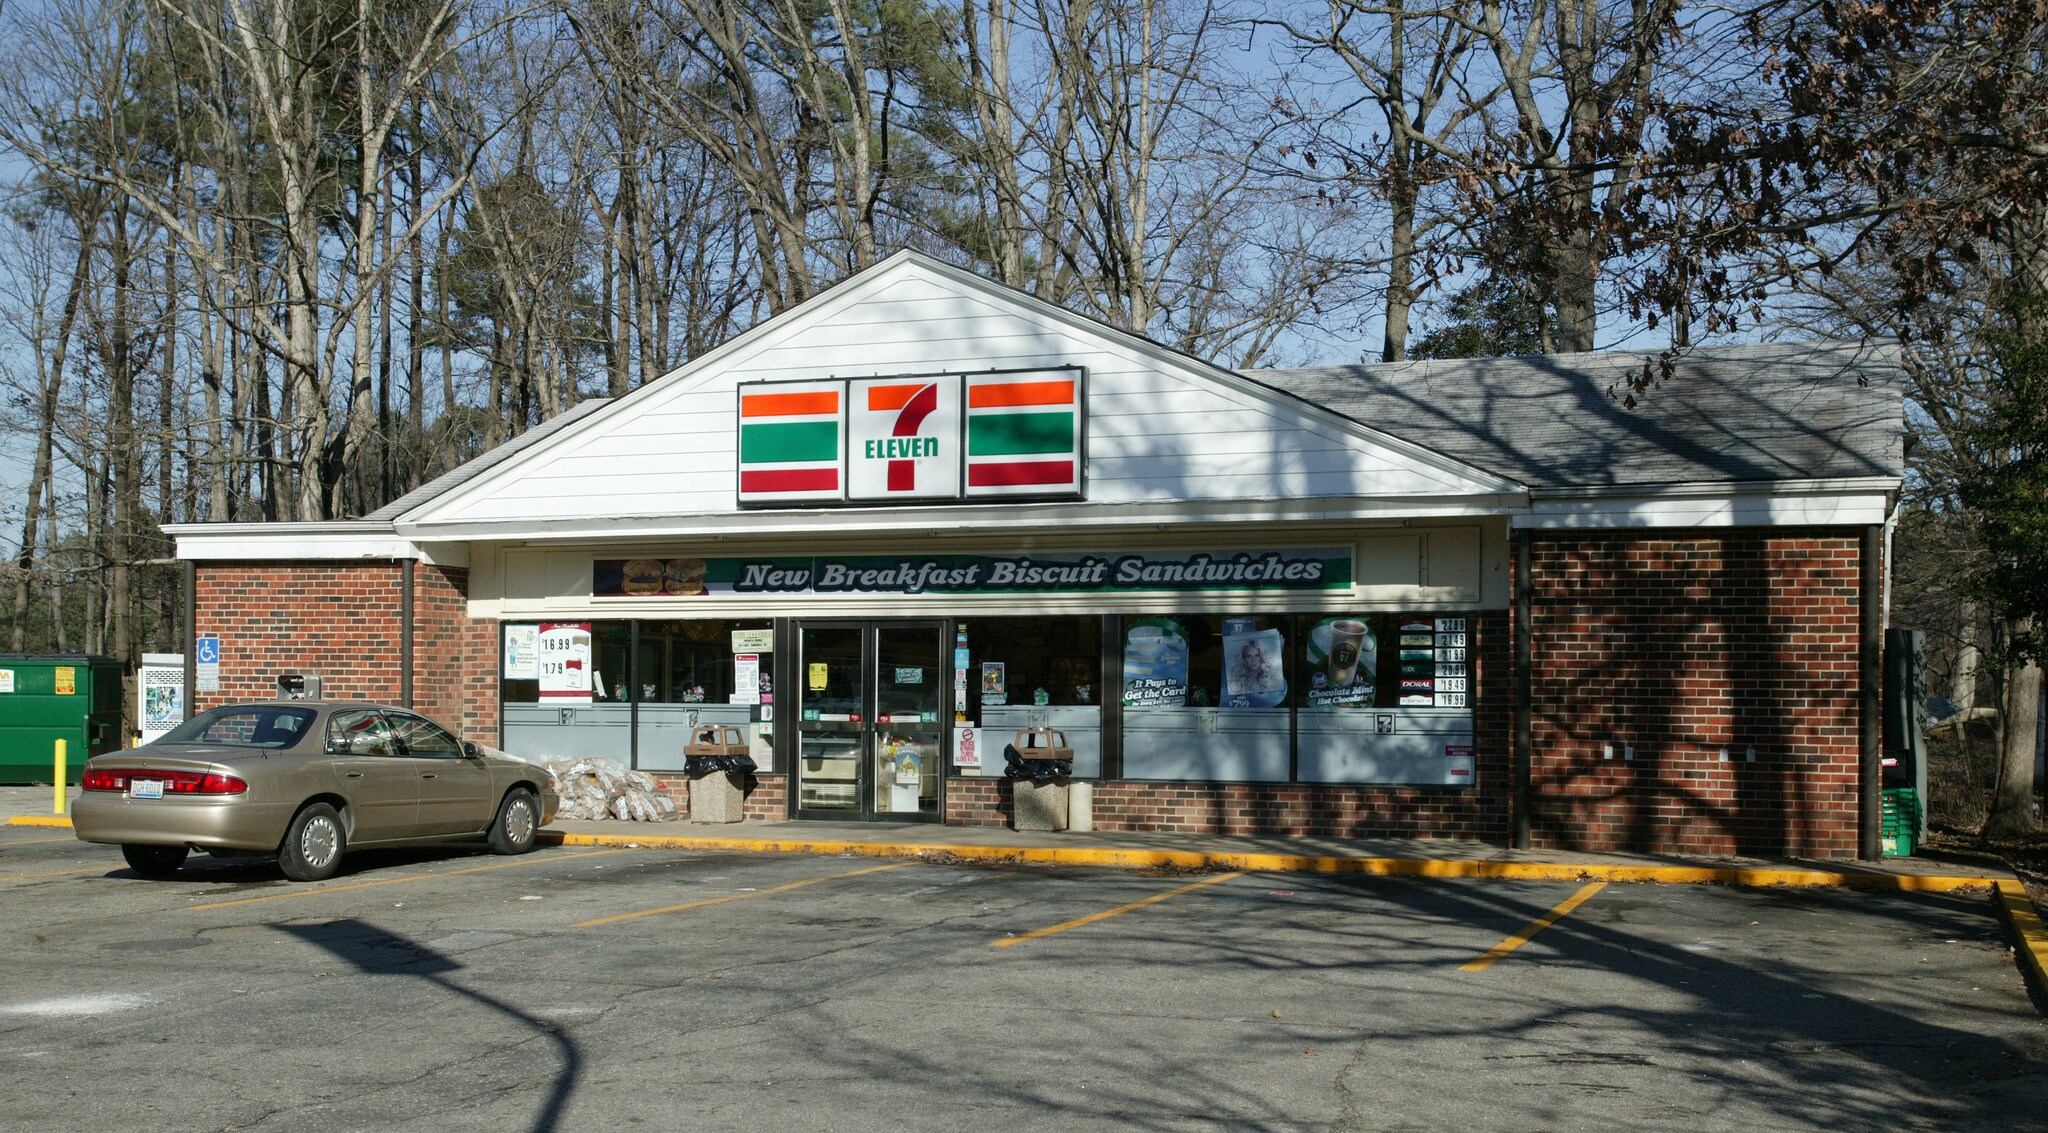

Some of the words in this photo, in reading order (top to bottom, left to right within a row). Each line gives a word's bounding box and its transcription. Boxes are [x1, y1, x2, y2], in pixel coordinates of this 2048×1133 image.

[868, 383, 937, 491] 7
[744, 563, 811, 587] New
[818, 562, 980, 590] Breakfast
[986, 559, 1108, 584] Biscuit
[1115, 555, 1323, 582] Sandwiches
[1134, 679, 1143, 689] It
[1144, 679, 1166, 688] Pays
[1124, 690, 1143, 700] Get
[1143, 688, 1160, 698] the
[1161, 685, 1187, 697] Card
[1308, 688, 1351, 698] Chocolate
[1351, 685, 1374, 694] Mint
[1332, 695, 1369, 703] Chocolate
